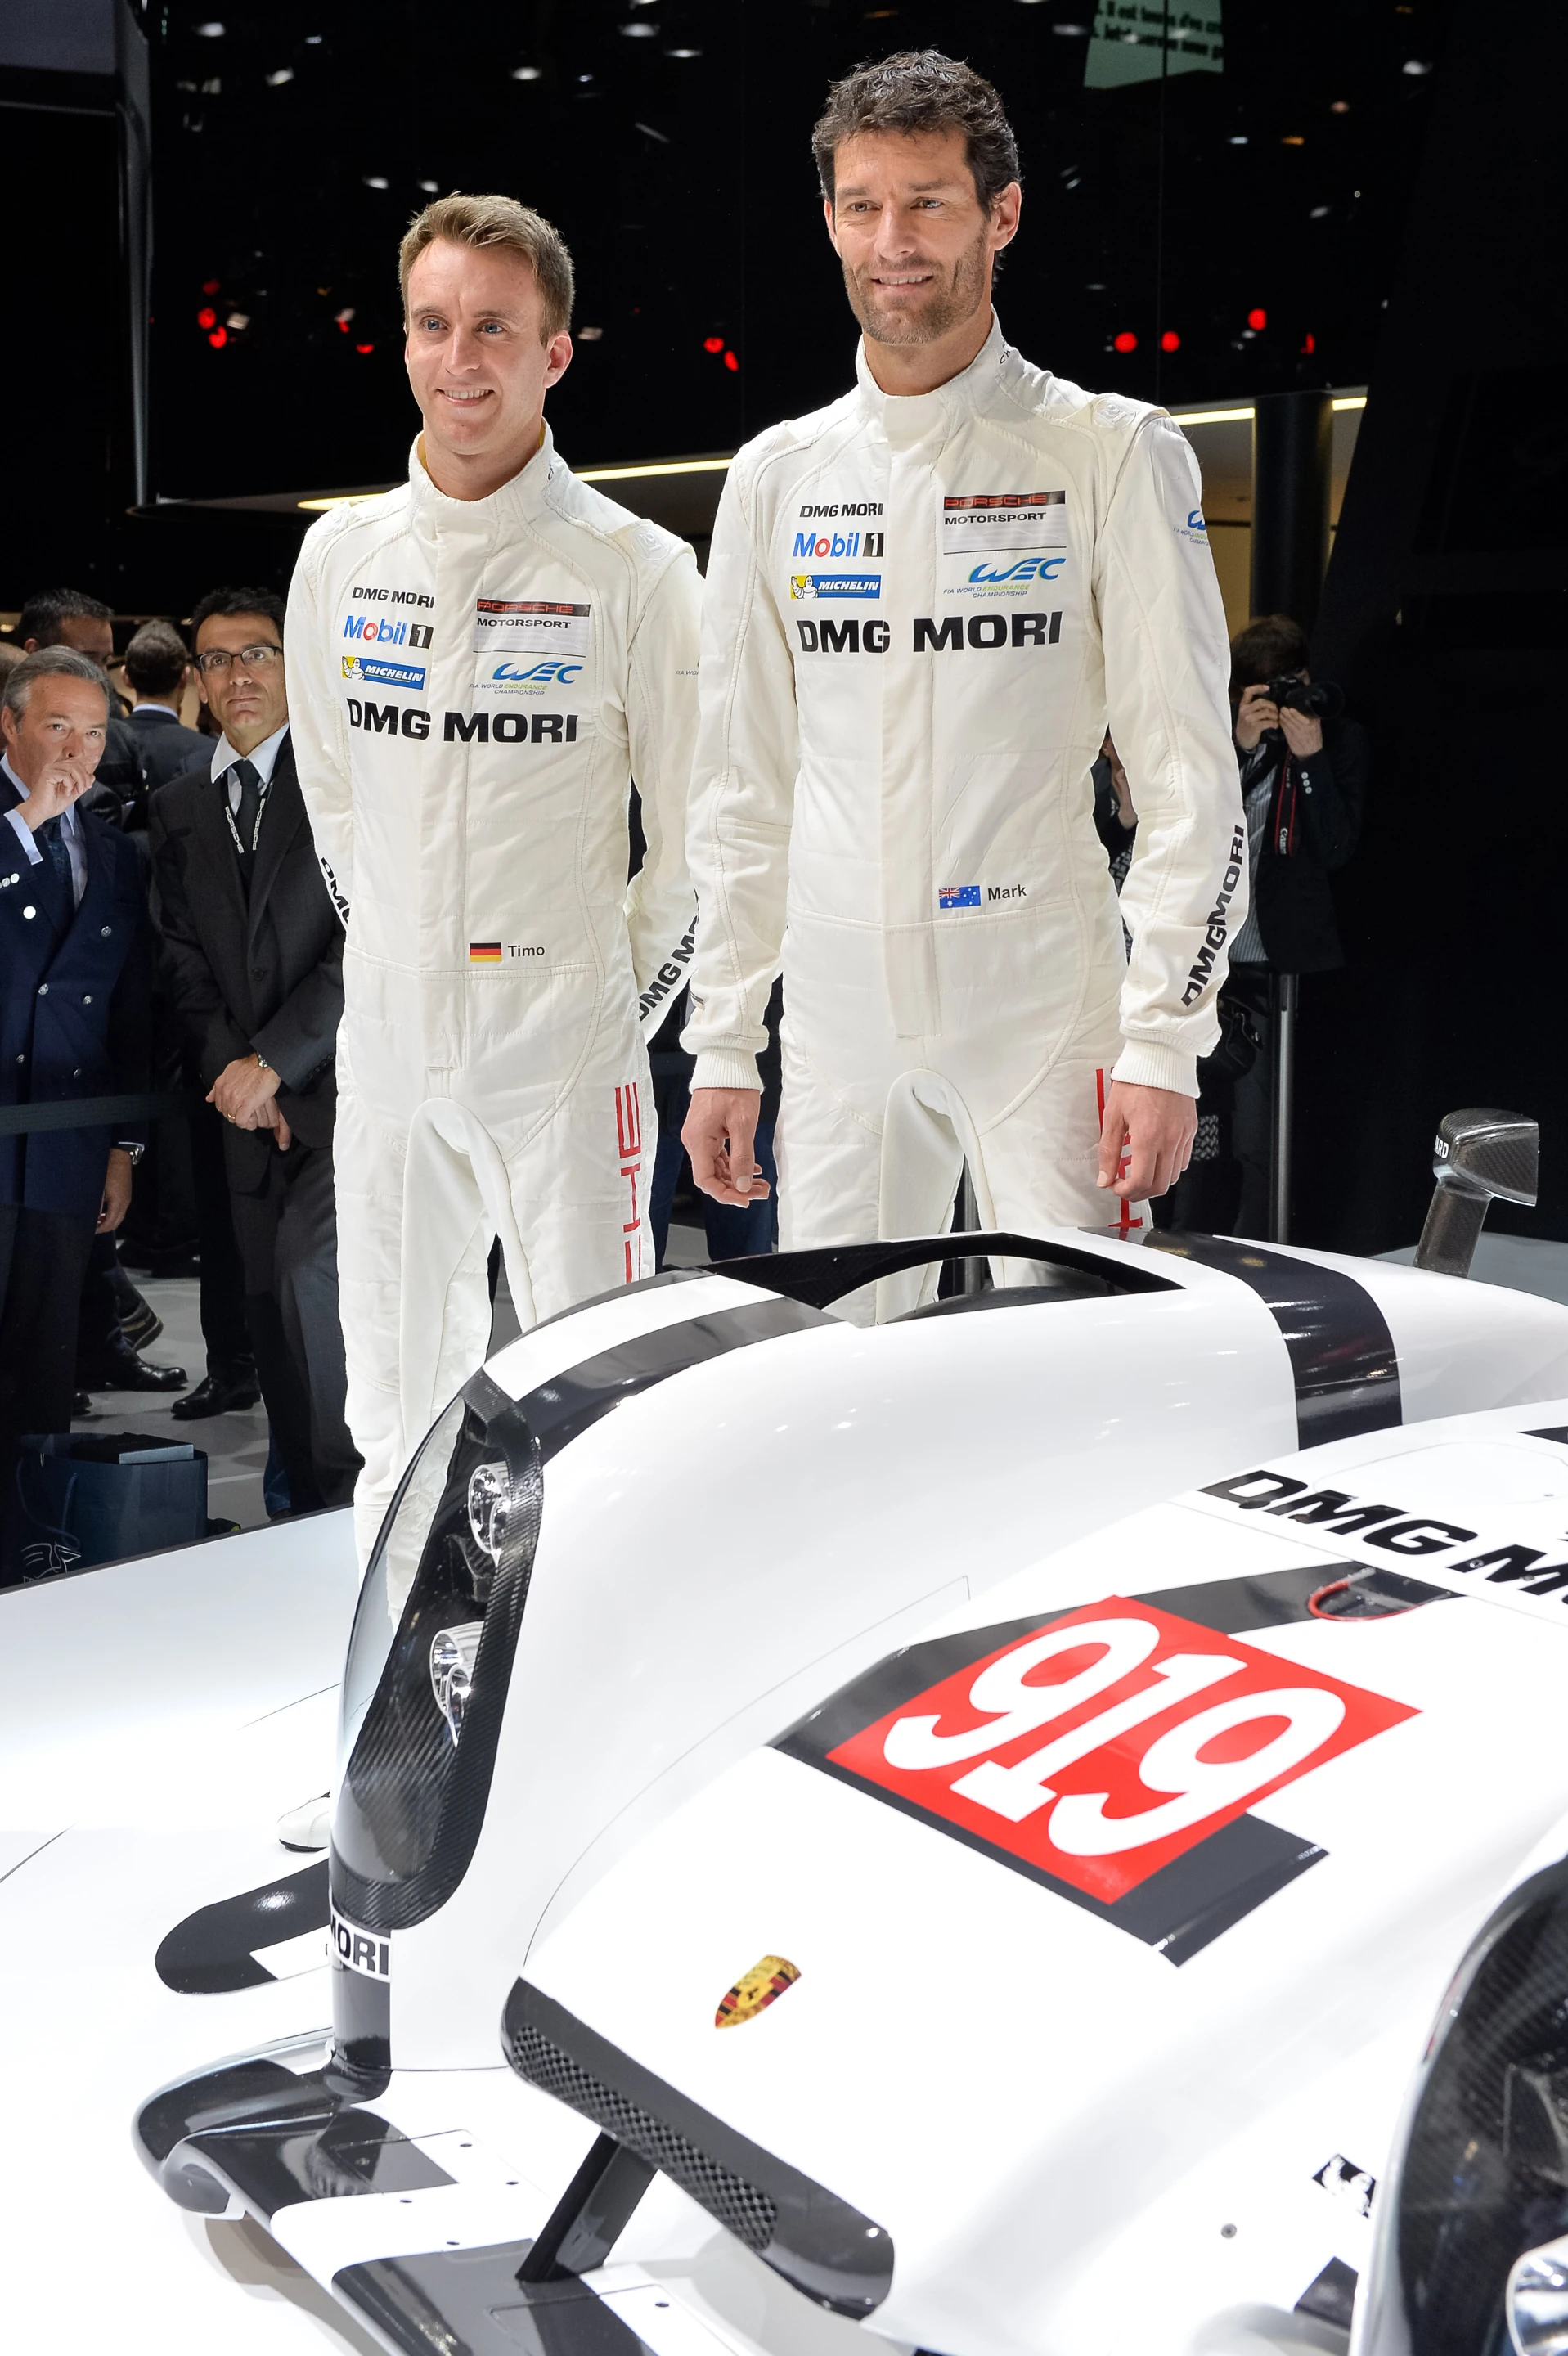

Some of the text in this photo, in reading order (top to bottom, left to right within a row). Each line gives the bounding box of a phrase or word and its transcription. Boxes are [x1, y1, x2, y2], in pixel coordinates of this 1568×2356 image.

[799, 502, 884, 518] DMG MORI
[945, 494, 1047, 508] PORSCHE
[944, 512, 1047, 525] MOTORSPORT
[793, 532, 860, 557] Mobil
[968, 557, 1067, 583] WEC
[818, 581, 880, 591] MICHELIN
[972, 591, 1028, 599] CHAMPIONSHIP
[982, 584, 1031, 592] ENDURANCE
[352, 587, 435, 609] DMG MORI
[477, 600, 573, 614] PORSCHE
[344, 615, 408, 645] Mobil
[477, 618, 572, 629] MOTORSPORT
[796, 611, 1063, 654] DMG MORI
[365, 664, 424, 682] MICHELIN
[492, 661, 583, 684] WEC
[346, 698, 579, 744] DMG MORI
[225, 806, 245, 854] PORSCHE
[987, 884, 1027, 901] Mark
[507, 945, 546, 958] Timo
[1197, 1470, 1478, 1555] DMG
[883, 1617, 1346, 1856] 919
